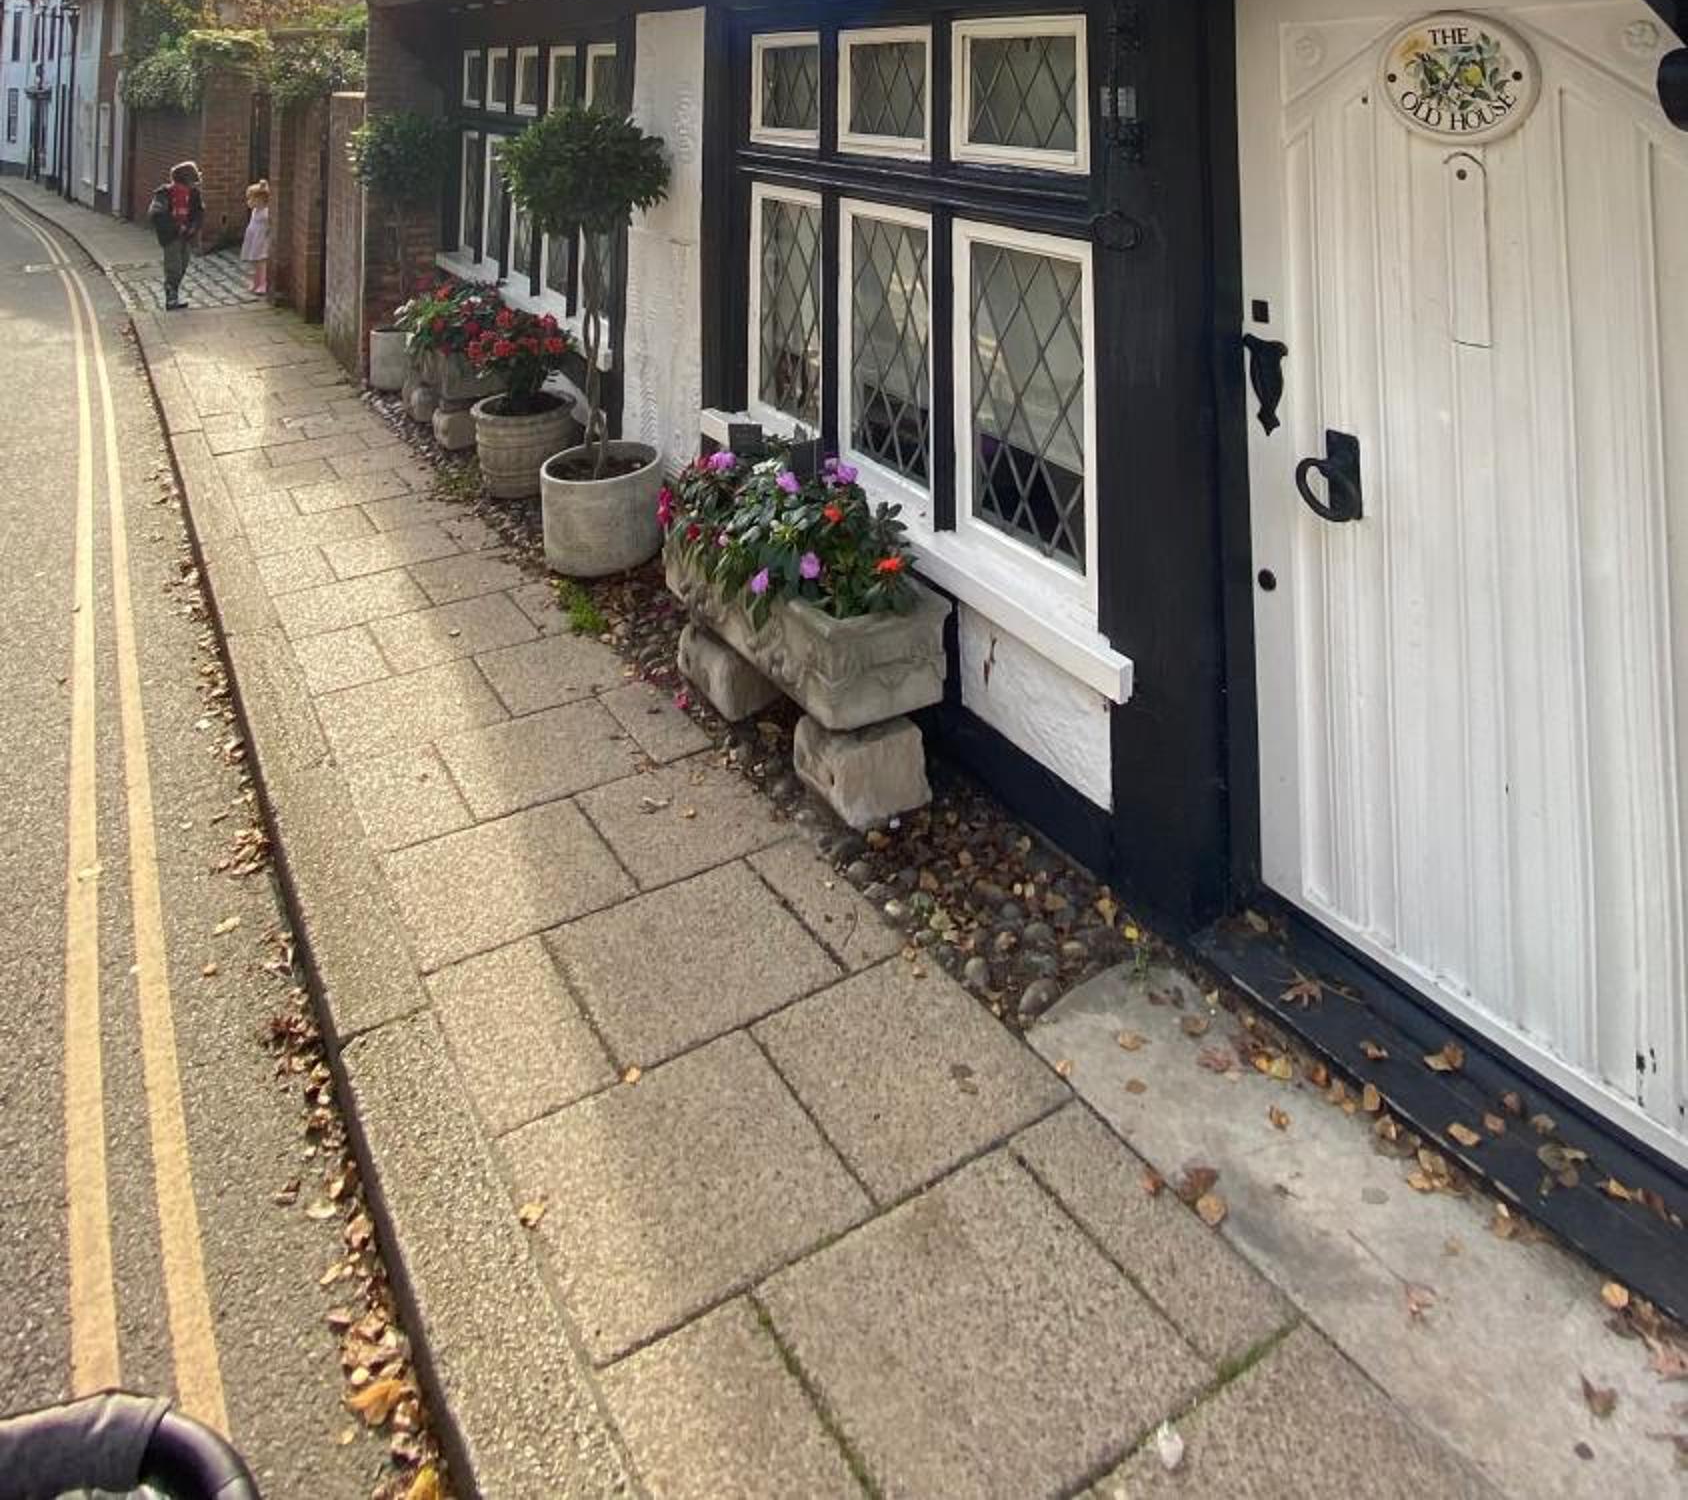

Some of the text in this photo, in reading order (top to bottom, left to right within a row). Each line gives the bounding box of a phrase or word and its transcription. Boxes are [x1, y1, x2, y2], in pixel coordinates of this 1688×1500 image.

[1428, 27, 1470, 45] THE
[1401, 91, 1516, 130] OLD HOUSE
